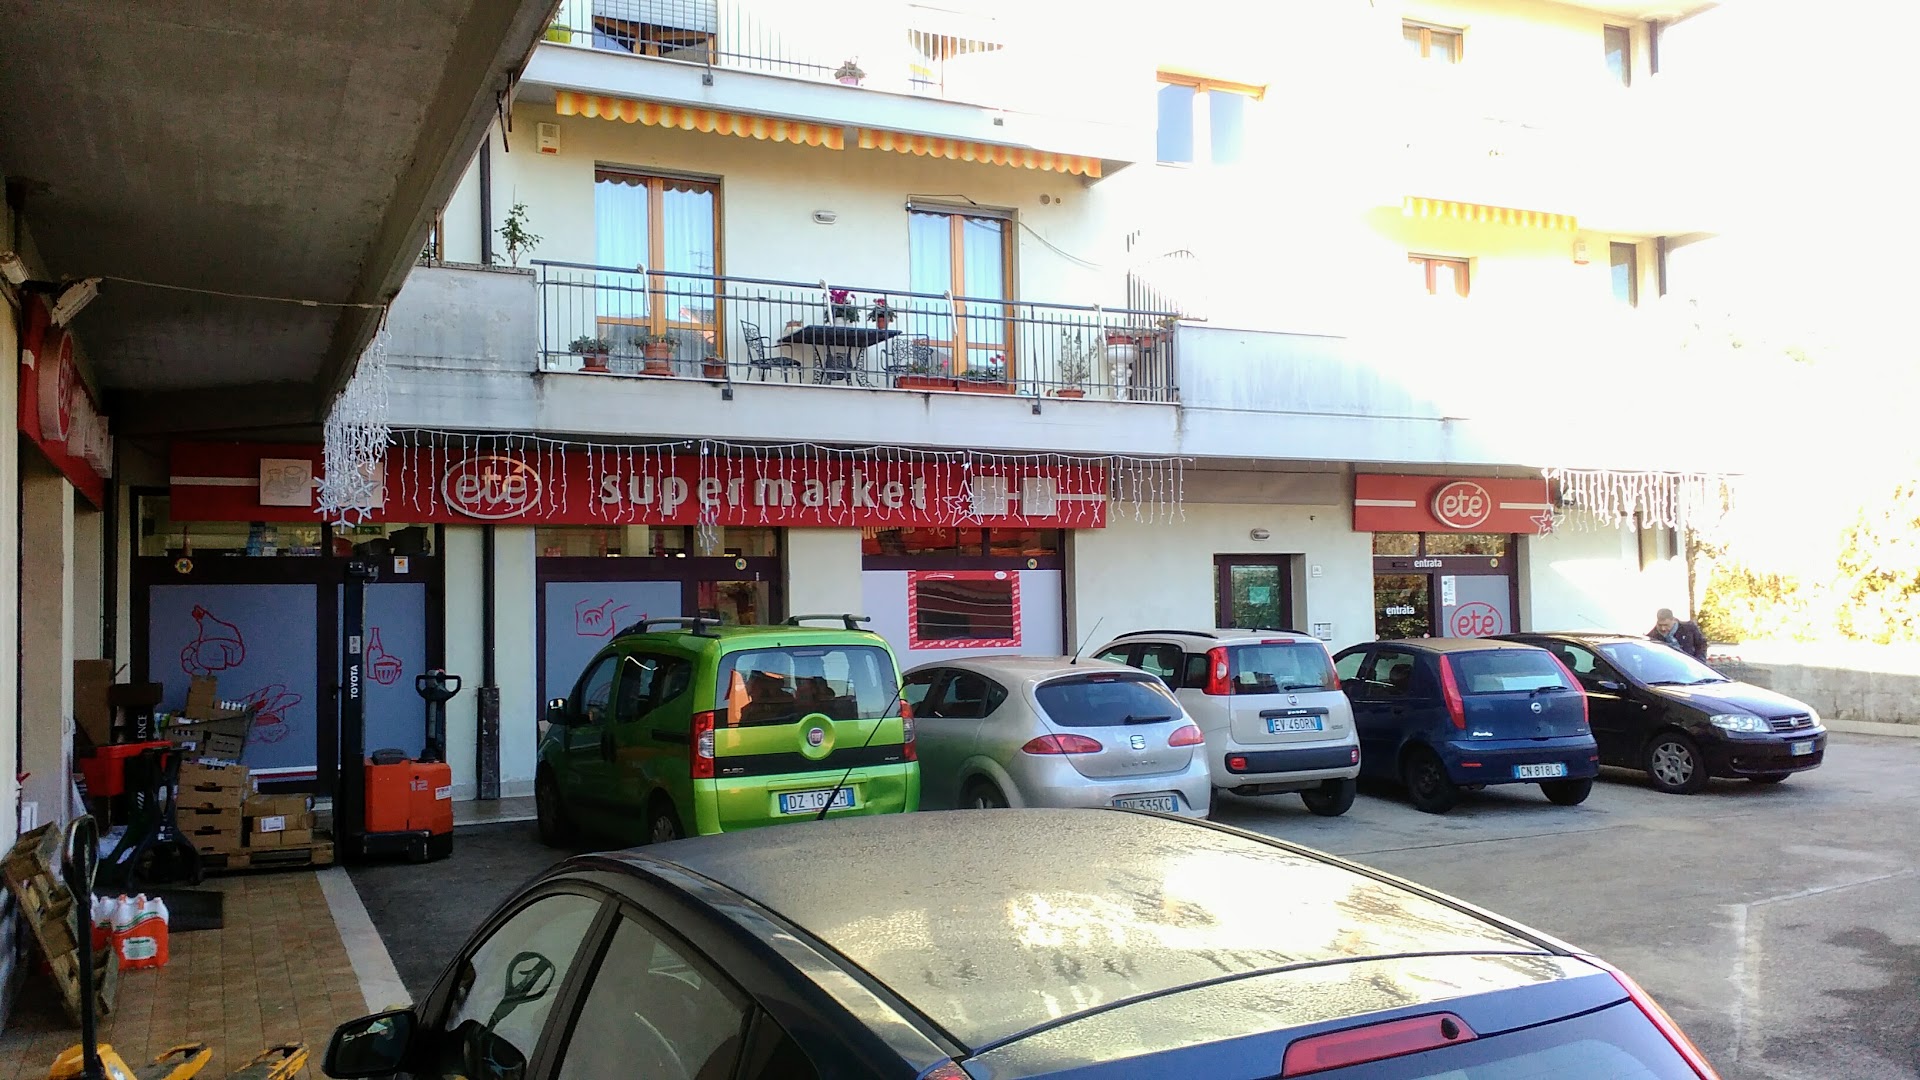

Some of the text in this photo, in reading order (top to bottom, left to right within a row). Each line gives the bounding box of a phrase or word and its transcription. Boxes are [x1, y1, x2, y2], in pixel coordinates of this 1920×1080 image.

[455, 464, 928, 516] eté supermarket
[1442, 487, 1484, 518] eté
[1413, 558, 1443, 569] entrata
[1385, 604, 1416, 616] entrata
[1457, 607, 1495, 637] eté
[350, 664, 359, 700] TOYOTA
[1274, 719, 1285, 731] EV
[1520, 765, 1561, 777] CN 818LS
[409, 779, 428, 792] 12
[789, 791, 847, 809] DZ 187H
